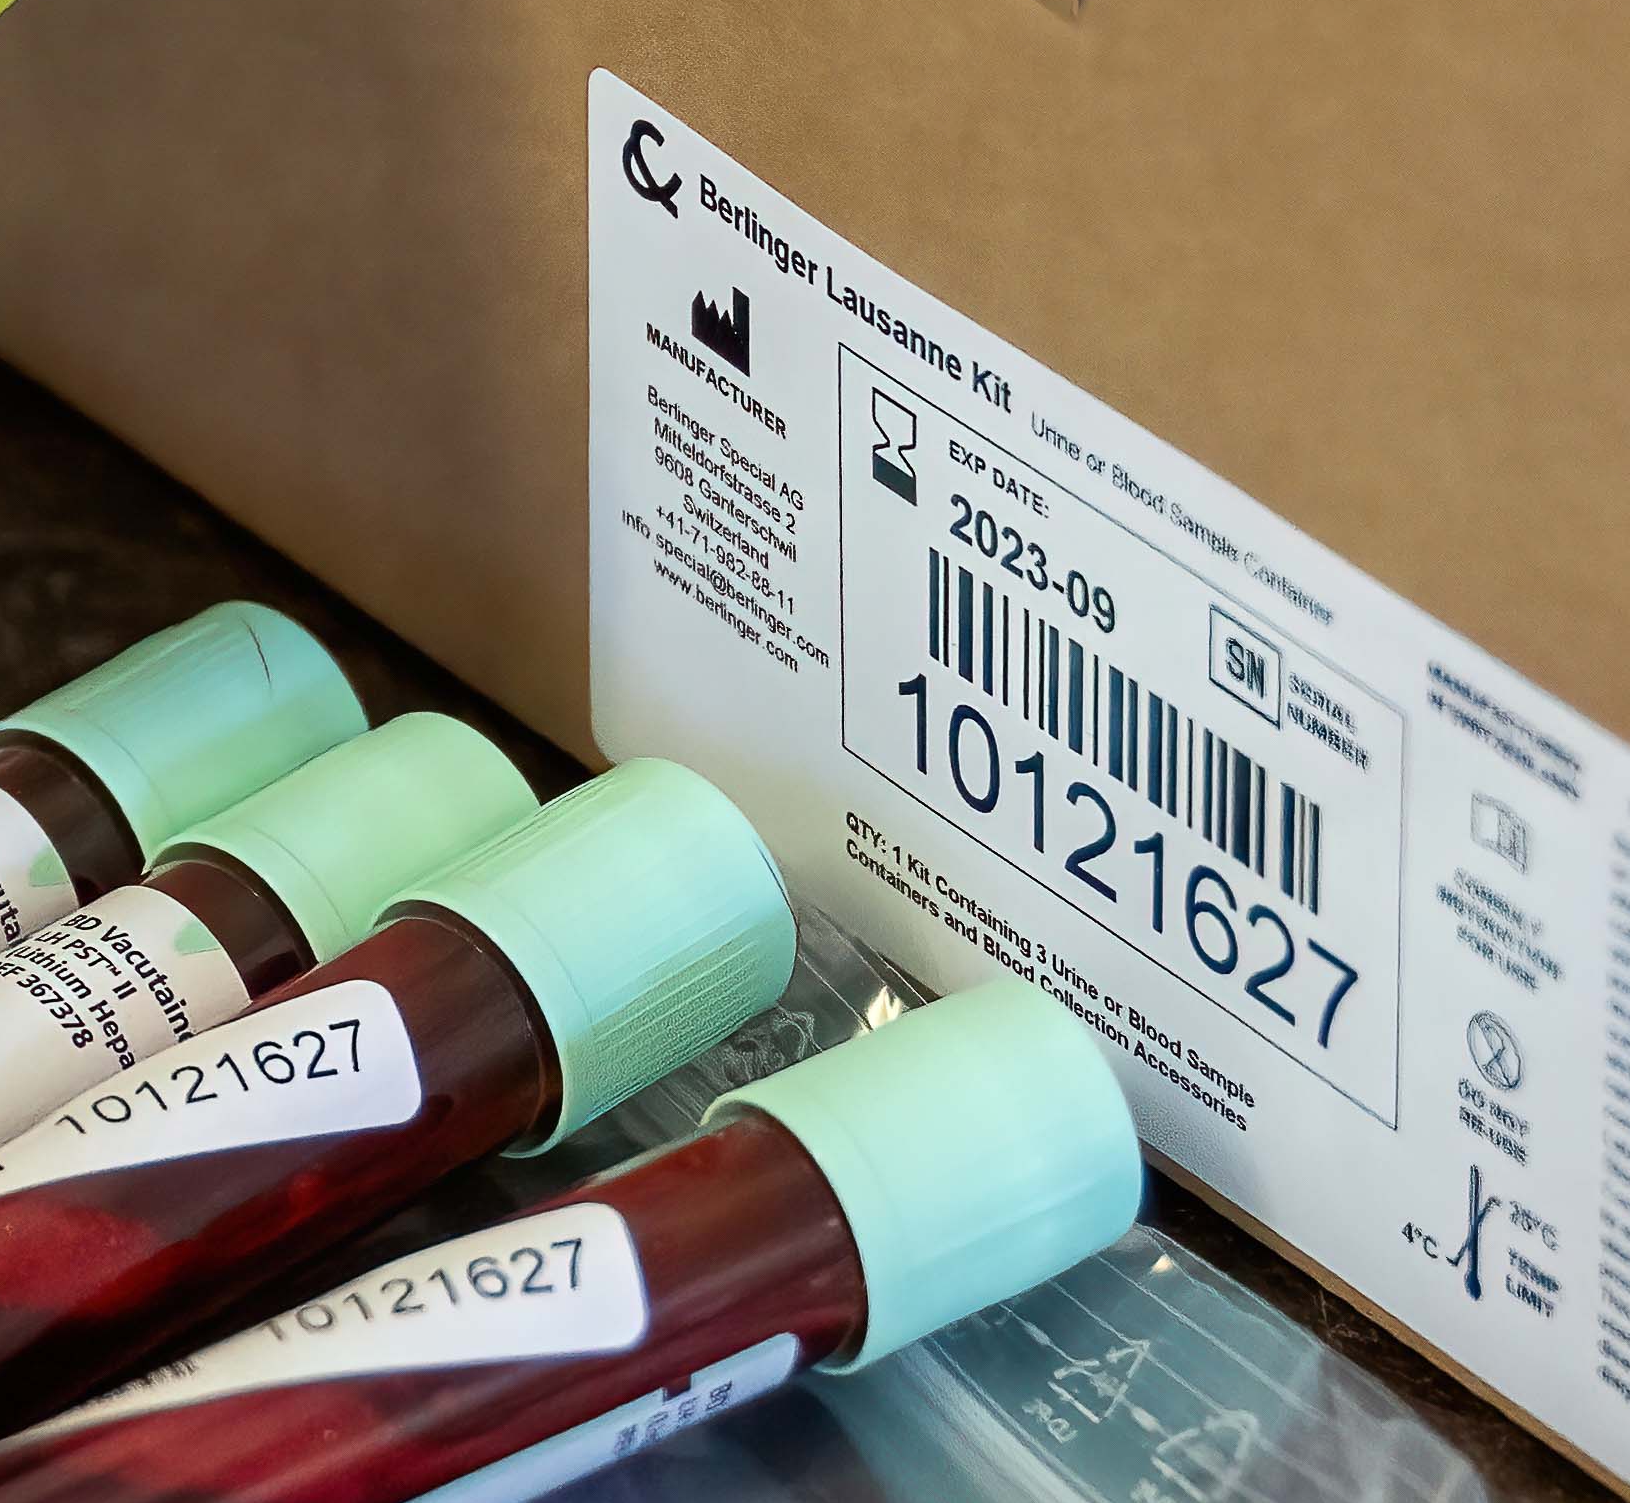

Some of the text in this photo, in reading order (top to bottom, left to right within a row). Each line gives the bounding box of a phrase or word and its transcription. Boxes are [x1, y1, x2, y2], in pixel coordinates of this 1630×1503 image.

[646, 322, 787, 439] MANUFACTURER
[699, 173, 819, 286] Berlinger
[826, 265, 963, 381] Lausanne
[971, 361, 1014, 415] Kit
[1030, 410, 1081, 463] Urine
[1085, 452, 1107, 476] or
[1111, 463, 1166, 515] Blood
[1169, 500, 1240, 564] Sample
[647, 384, 805, 512] Berlinger Special AG
[654, 416, 798, 535] Mitteldorfstrasse 2
[654, 445, 798, 563] 9608 Ganterschwil
[948, 439, 1051, 519] EXP DATE:
[682, 493, 770, 570] Switzerland
[948, 493, 1117, 634] 2023-09
[653, 559, 800, 674] www.berlinger.com
[1224, 636, 1267, 699] SN
[1286, 701, 1371, 771] NUMBER
[1287, 671, 1358, 734] SERIAL
[897, 672, 1359, 1050] 10121627
[33, 930, 72, 946] LH
[112, 979, 138, 1001] II
[60, 913, 102, 932] BD
[845, 810, 1256, 1110] QTY: 1 Kit Containing 3 Urine or Blood Sample
[5, 945, 136, 1072] (Lithium Hepa
[17, 972, 95, 1050] 367378
[844, 838, 1248, 1132] Containers and Blood Collection Accessories
[54, 1017, 365, 1136] 10121627
[260, 1237, 587, 1345] 10121627
[1401, 1220, 1439, 1260] 4°C
